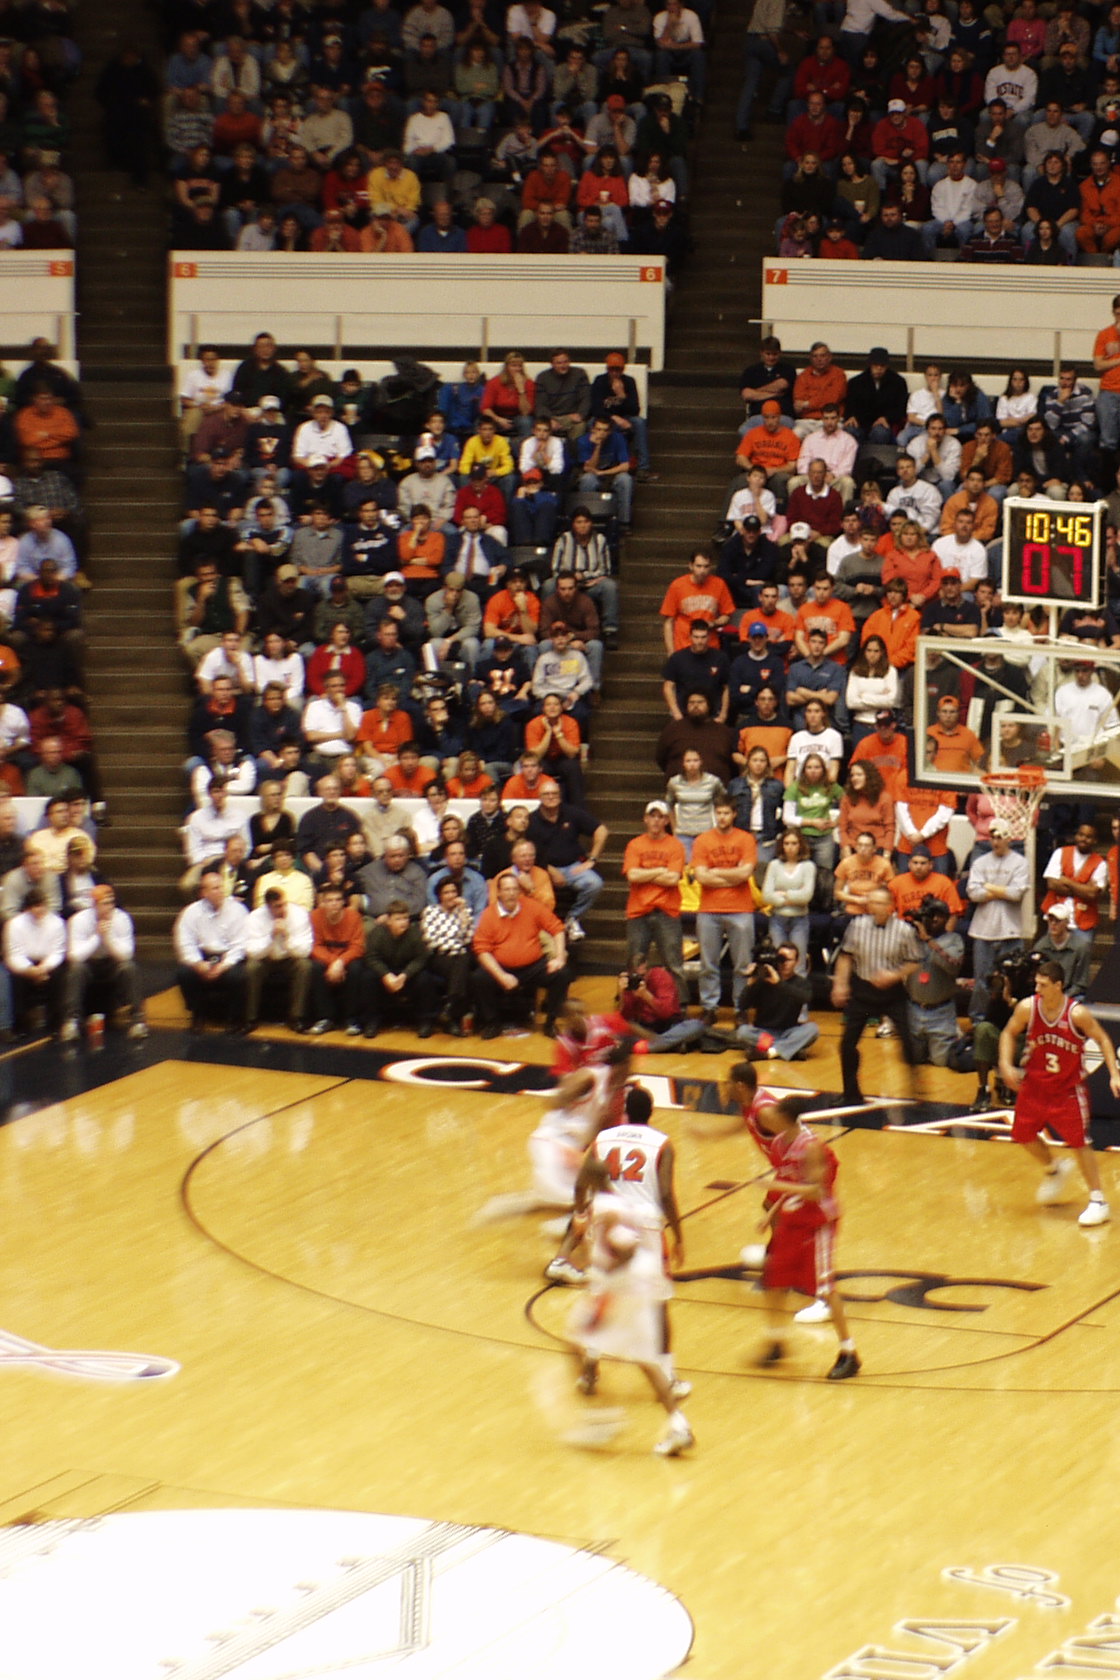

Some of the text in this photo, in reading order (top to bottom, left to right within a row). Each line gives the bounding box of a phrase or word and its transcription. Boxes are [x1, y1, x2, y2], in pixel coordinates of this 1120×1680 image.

[645, 268, 656, 281] 6
[772, 270, 782, 283] 7
[1025, 512, 1092, 547] 10:46
[1021, 543, 1083, 596] 07
[1044, 1052, 1061, 1073] 3
[603, 1147, 647, 1183] 42
